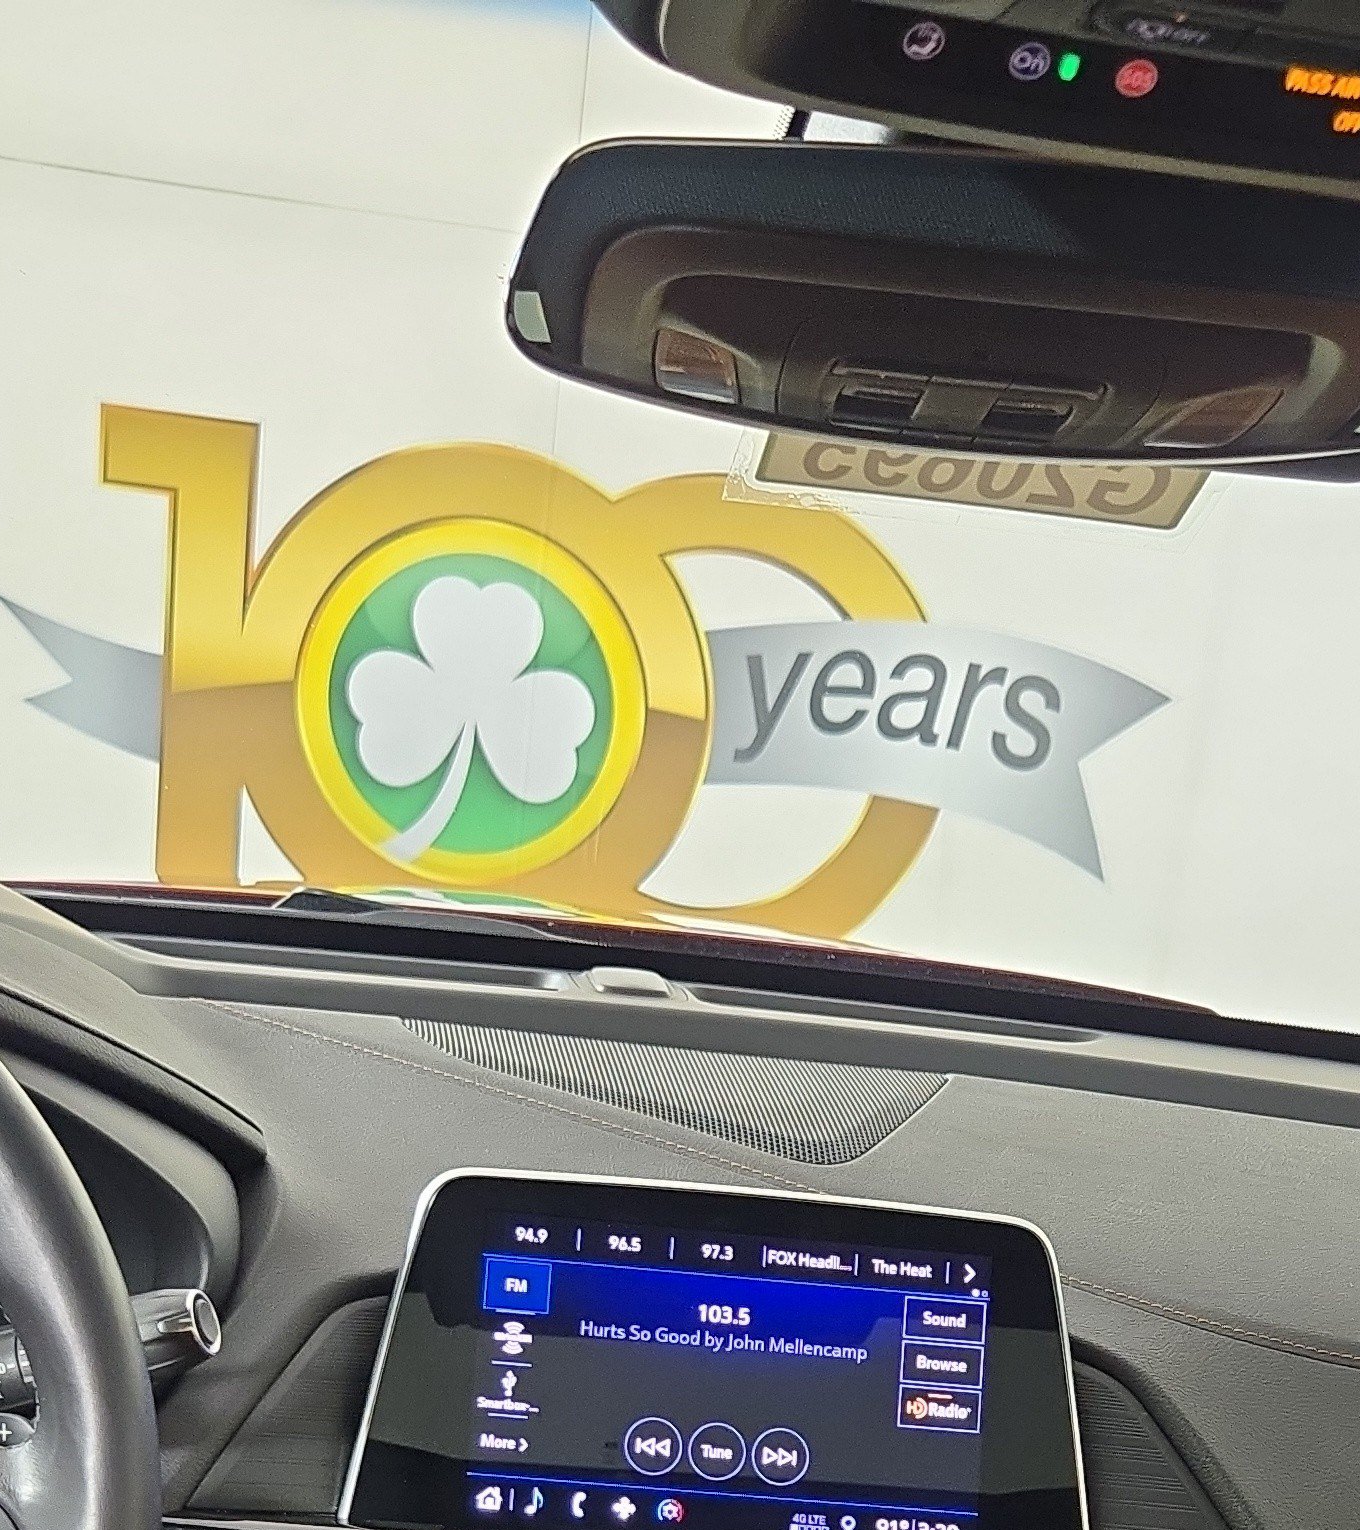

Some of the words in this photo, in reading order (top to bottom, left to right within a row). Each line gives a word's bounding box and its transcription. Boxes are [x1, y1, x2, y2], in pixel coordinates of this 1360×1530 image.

[730, 650, 1064, 774] years
[515, 1226, 549, 1243] 94.9
[608, 1235, 642, 1252] 96.5
[701, 1243, 734, 1260] 97.3
[768, 1249, 797, 1266] FOX
[871, 1258, 898, 1275] The
[900, 1262, 933, 1278] Heat
[504, 1277, 528, 1293] FM
[698, 1304, 751, 1325] 103.5
[922, 1310, 967, 1329] Sound
[580, 1320, 626, 1340] Hurts
[628, 1324, 651, 1342] So
[655, 1327, 701, 1346] Good
[704, 1330, 724, 1352] by
[725, 1333, 765, 1352] John
[768, 1336, 868, 1364] Mellencamp
[916, 1355, 968, 1373] Browse
[479, 1433, 517, 1450] More
[700, 1444, 733, 1460] Tune
[792, 1513, 806, 1524] 4G
[808, 1514, 827, 1526] LTE
